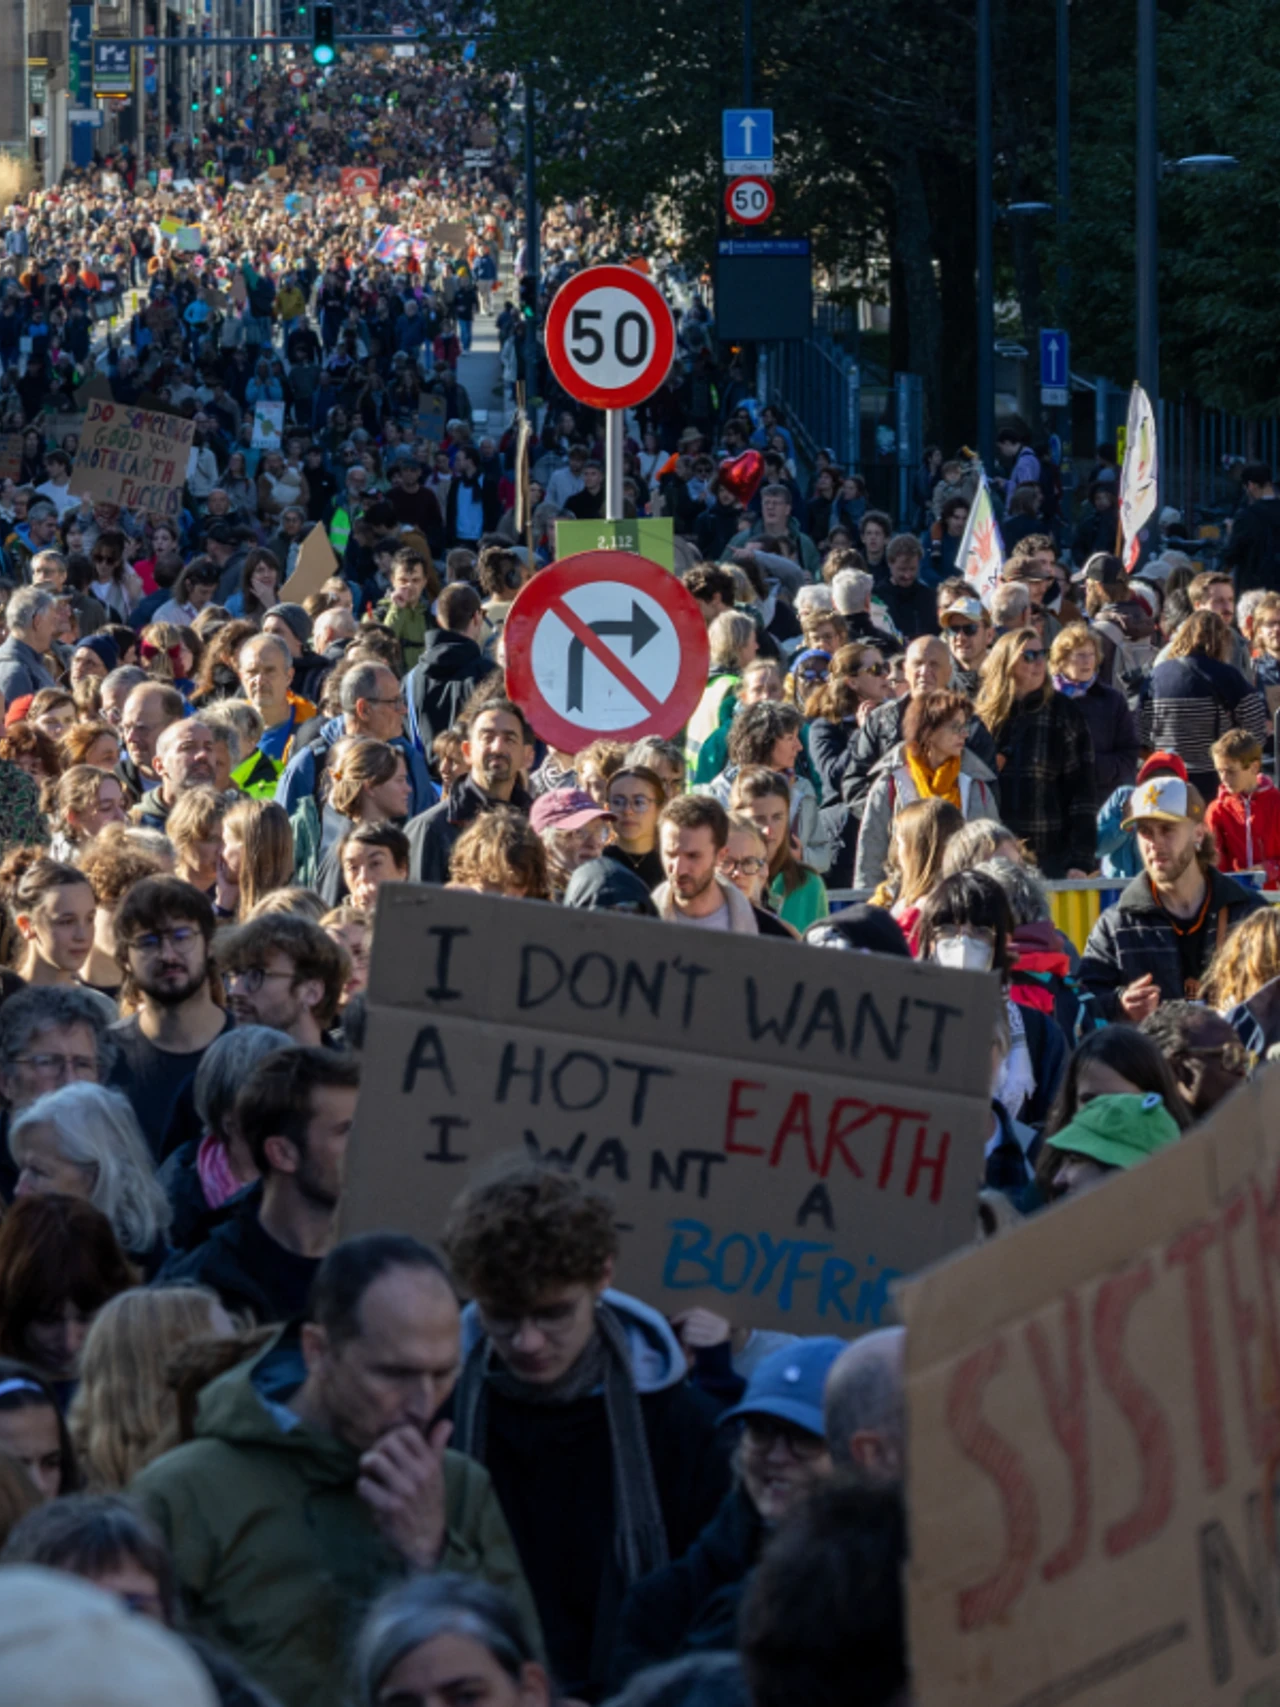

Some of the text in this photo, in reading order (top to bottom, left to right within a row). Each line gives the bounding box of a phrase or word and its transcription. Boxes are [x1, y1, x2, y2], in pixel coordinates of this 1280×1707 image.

[734, 190, 766, 211] 50
[570, 309, 649, 368] 50
[87, 402, 116, 423] DO
[596, 535, 634, 550] 2,112
[425, 925, 964, 1074] I DON'T WANT
[402, 1023, 952, 1205] A HOT EARTH
[423, 1115, 728, 1200] I WANT
[796, 1181, 836, 1232] A
